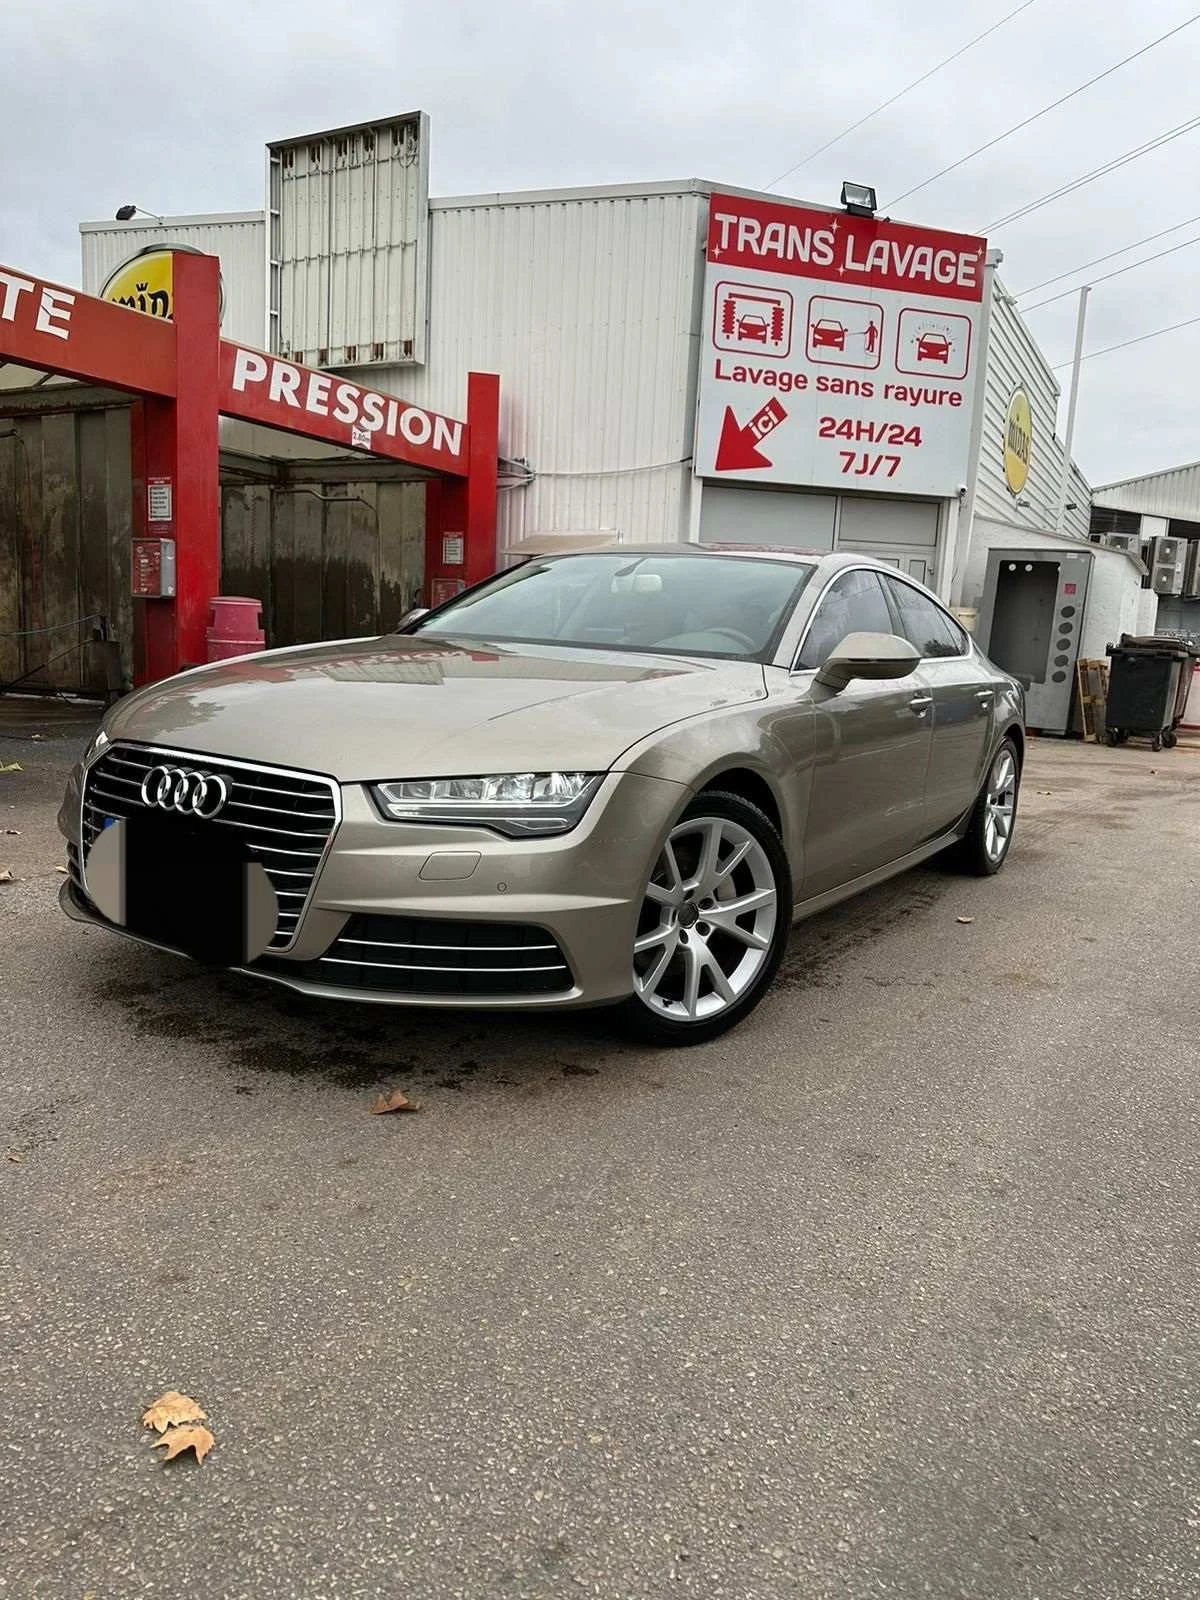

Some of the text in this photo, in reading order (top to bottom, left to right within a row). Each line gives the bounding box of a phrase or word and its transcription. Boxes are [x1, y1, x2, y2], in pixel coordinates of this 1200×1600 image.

[714, 212, 979, 288] TRANS LAVAGE
[232, 348, 463, 456] PRESSION
[714, 358, 963, 407] Lavage sans rayure
[818, 416, 922, 447] 24H/24
[839, 451, 902, 477] 7J/7
